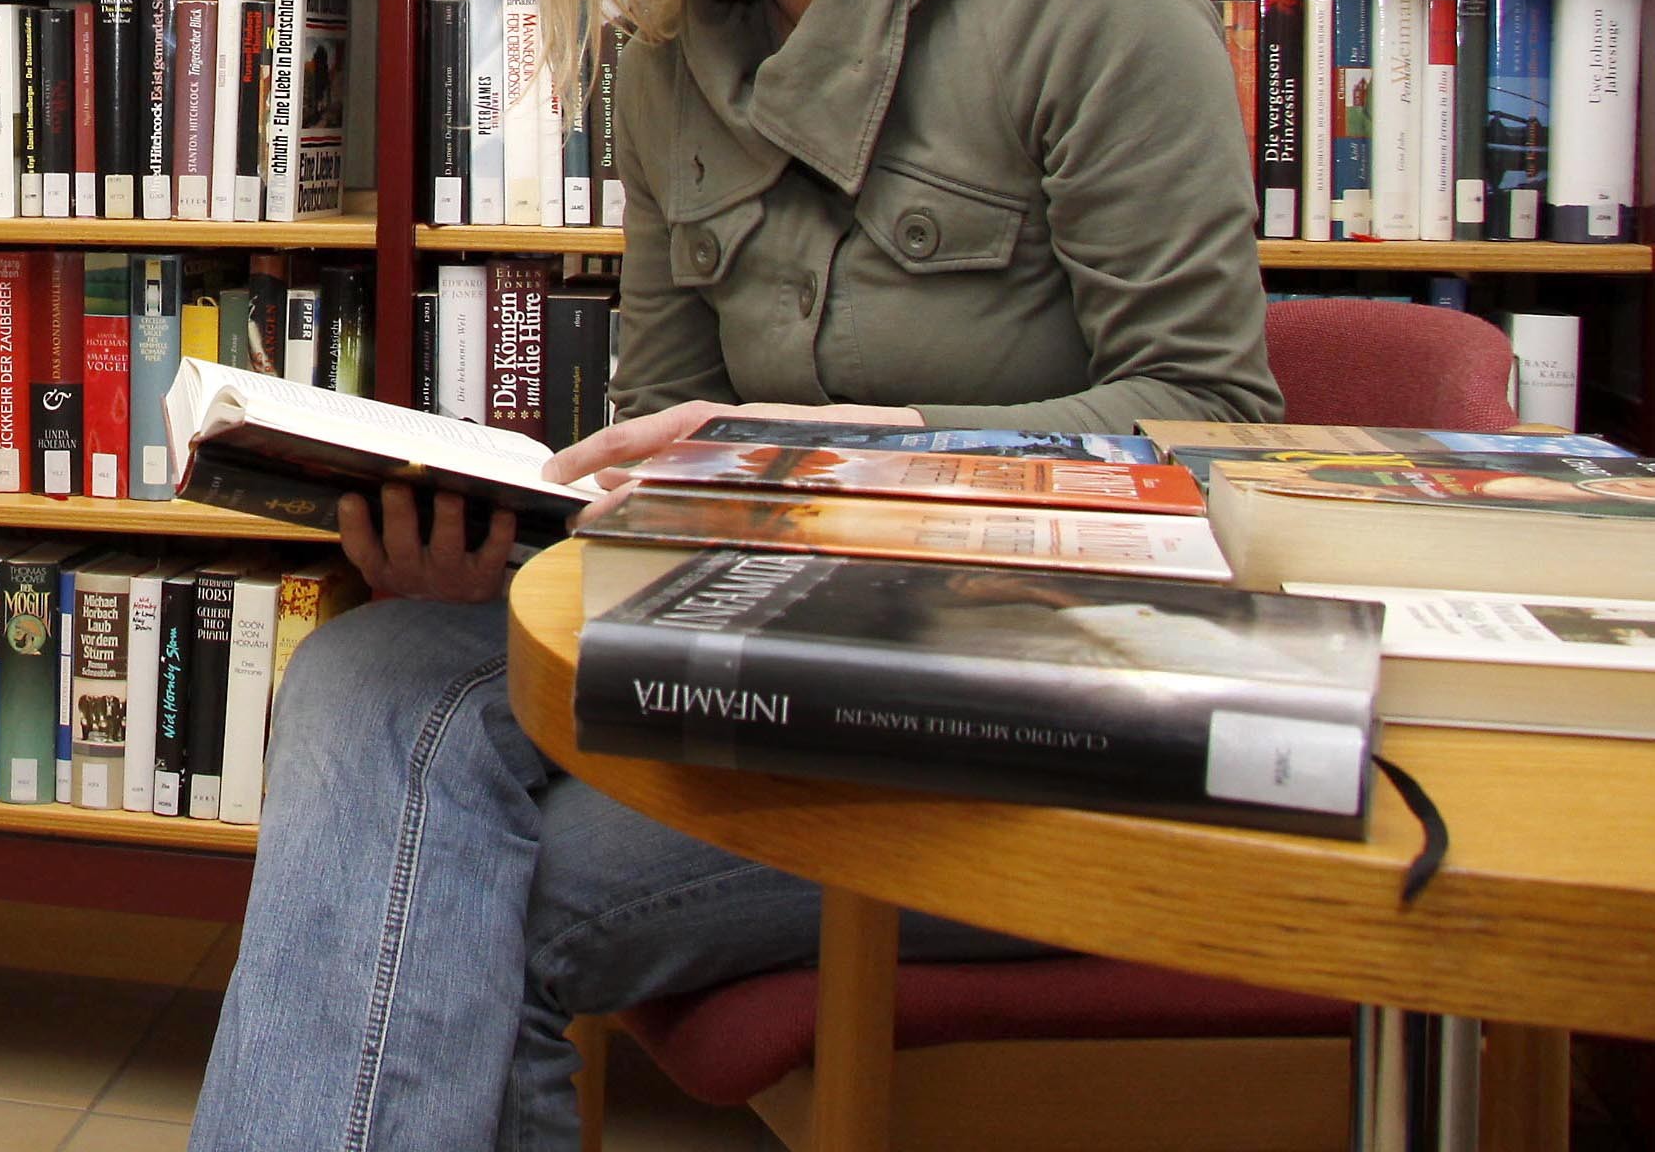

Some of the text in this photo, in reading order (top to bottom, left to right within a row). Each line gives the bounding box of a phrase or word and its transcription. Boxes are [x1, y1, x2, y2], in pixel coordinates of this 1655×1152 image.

[278, 55, 292, 65] in
[277, 68, 293, 102] Liebe
[1264, 43, 1281, 162] Die vergessene
[275, 103, 292, 127] Eine
[601, 64, 613, 167] Über tausend Hügel
[1281, 78, 1295, 162] Prinzessin
[301, 302, 312, 339] PIPER
[0, 281, 14, 452] ÜCKKEHR DER ZAUBERER
[493, 292, 525, 408] Die Königin
[517, 292, 541, 408] und die Hure
[83, 595, 116, 607] Michael
[83, 606, 118, 620] Horbach
[81, 634, 119, 647] vor dem
[87, 620, 111, 633] Laub
[83, 646, 115, 662] Sturm
[633, 678, 790, 726] INFAMITÀ
